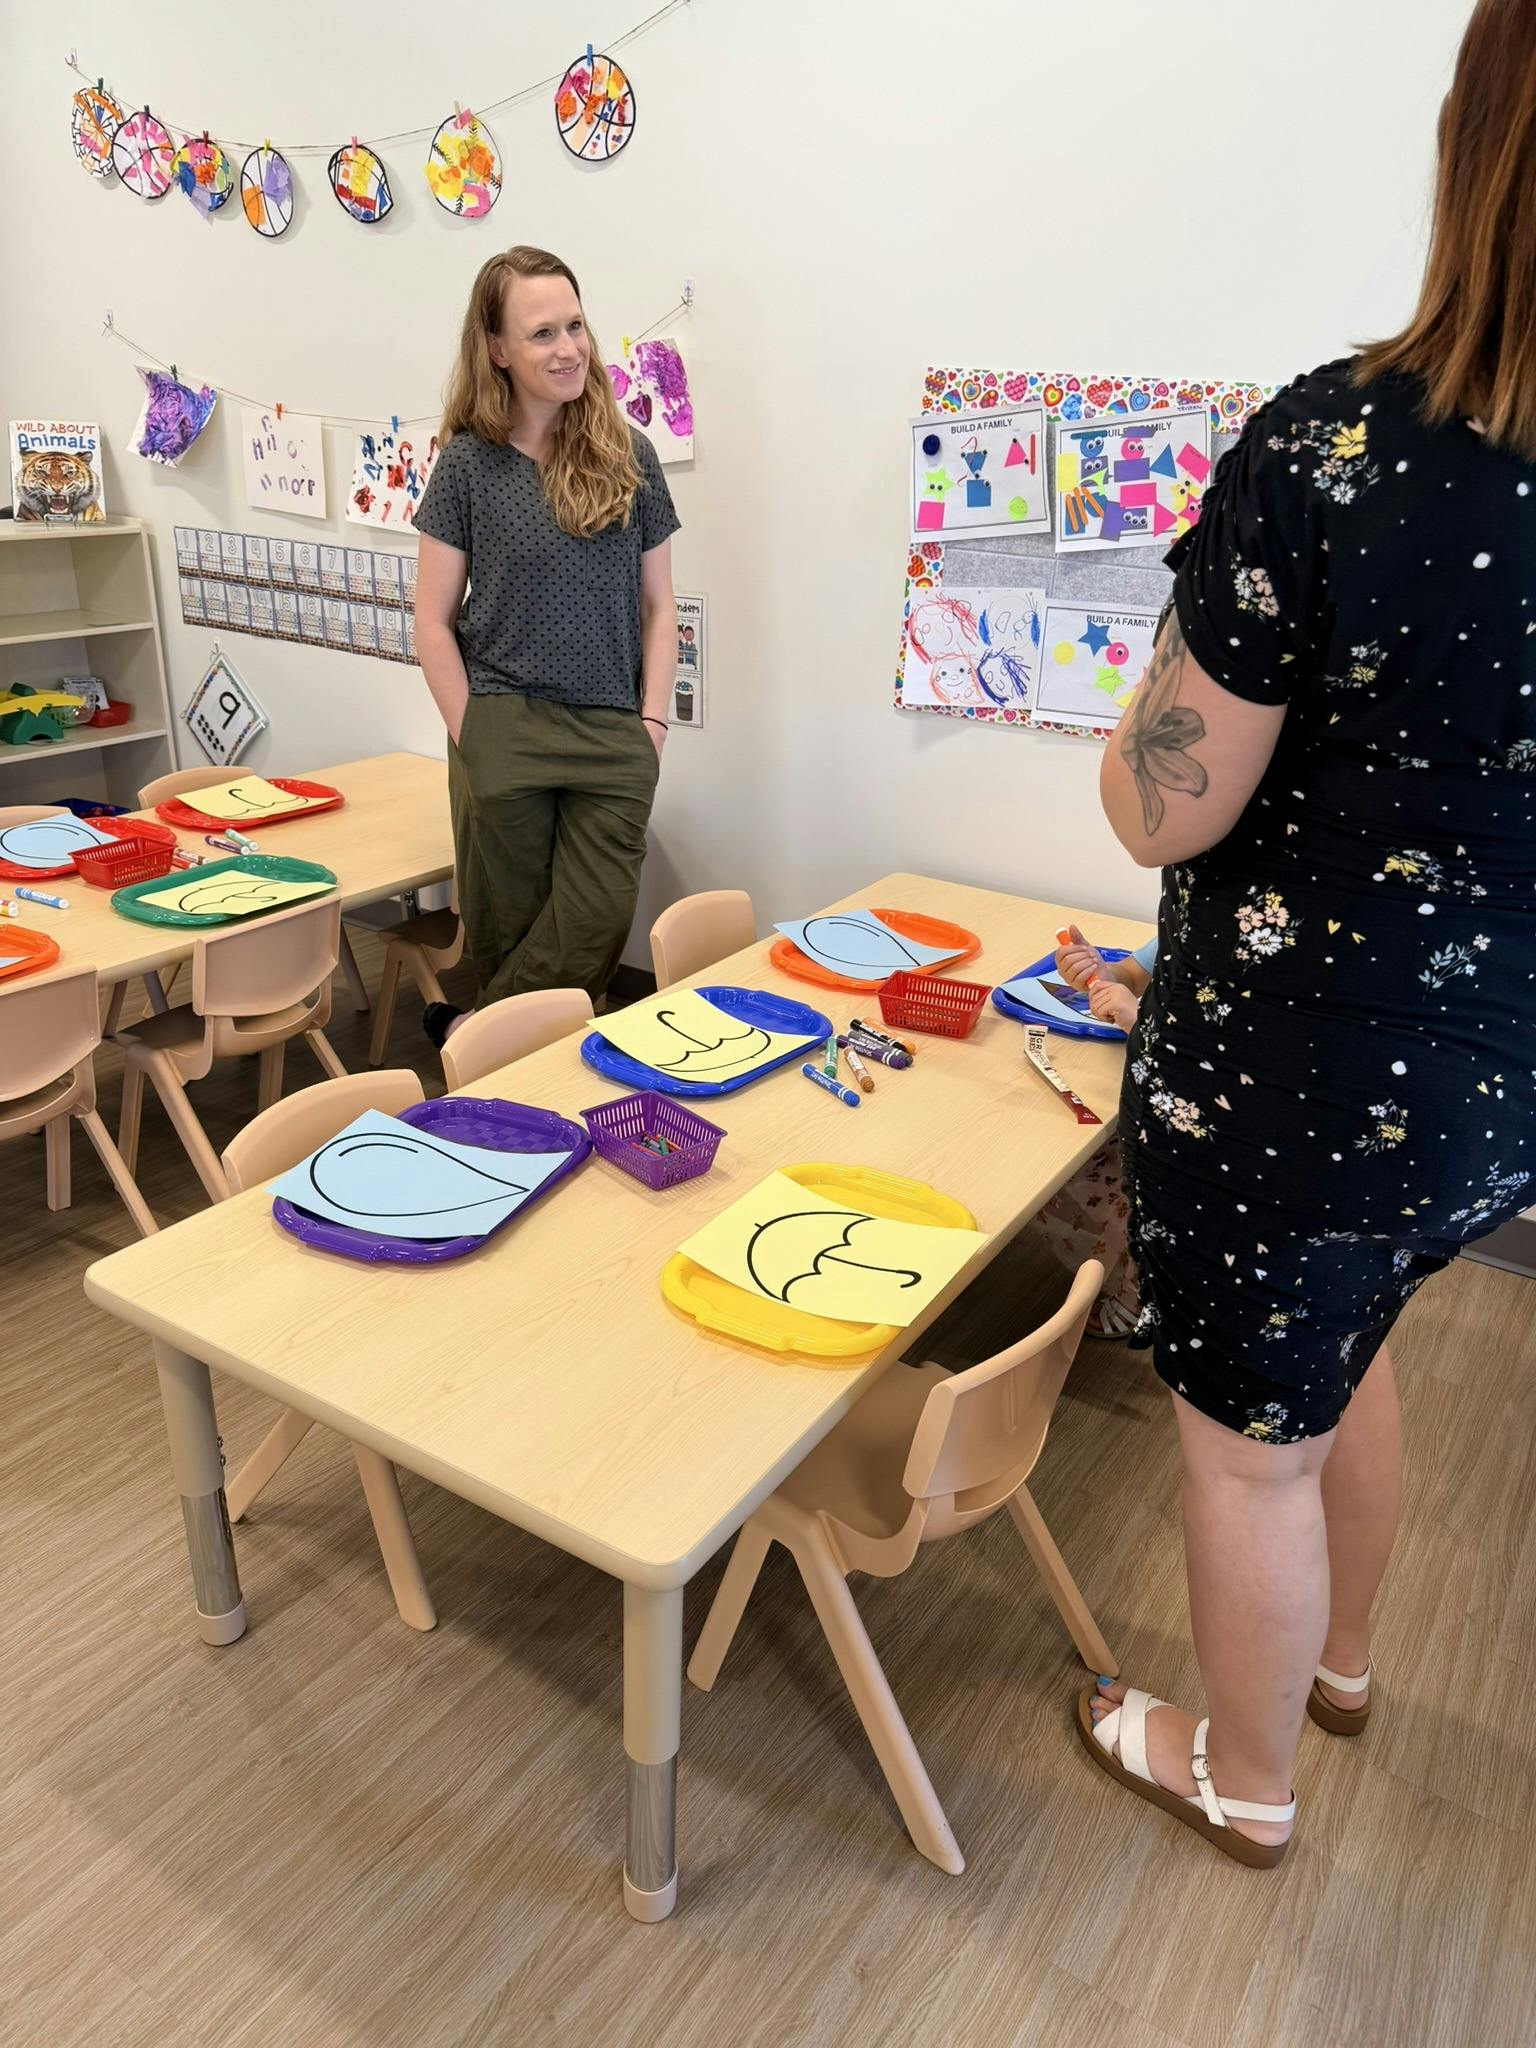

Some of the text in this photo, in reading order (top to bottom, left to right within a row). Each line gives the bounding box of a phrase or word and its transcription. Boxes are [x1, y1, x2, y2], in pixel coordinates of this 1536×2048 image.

[16, 422, 95, 434] WILD ABOUT
[950, 418, 1013, 435] BUILD A FAMILY
[17, 433, 97, 450] Animals
[204, 533, 214, 552] 2
[228, 536, 237, 555] 3
[251, 539, 261, 559] 4
[275, 542, 284, 561] 5
[300, 545, 310, 565] 6
[327, 549, 337, 569] 7
[354, 553, 364, 573] 8
[381, 557, 391, 577] 9
[676, 602, 700, 614] nders
[1086, 614, 1156, 628] BUILD A FAMILY
